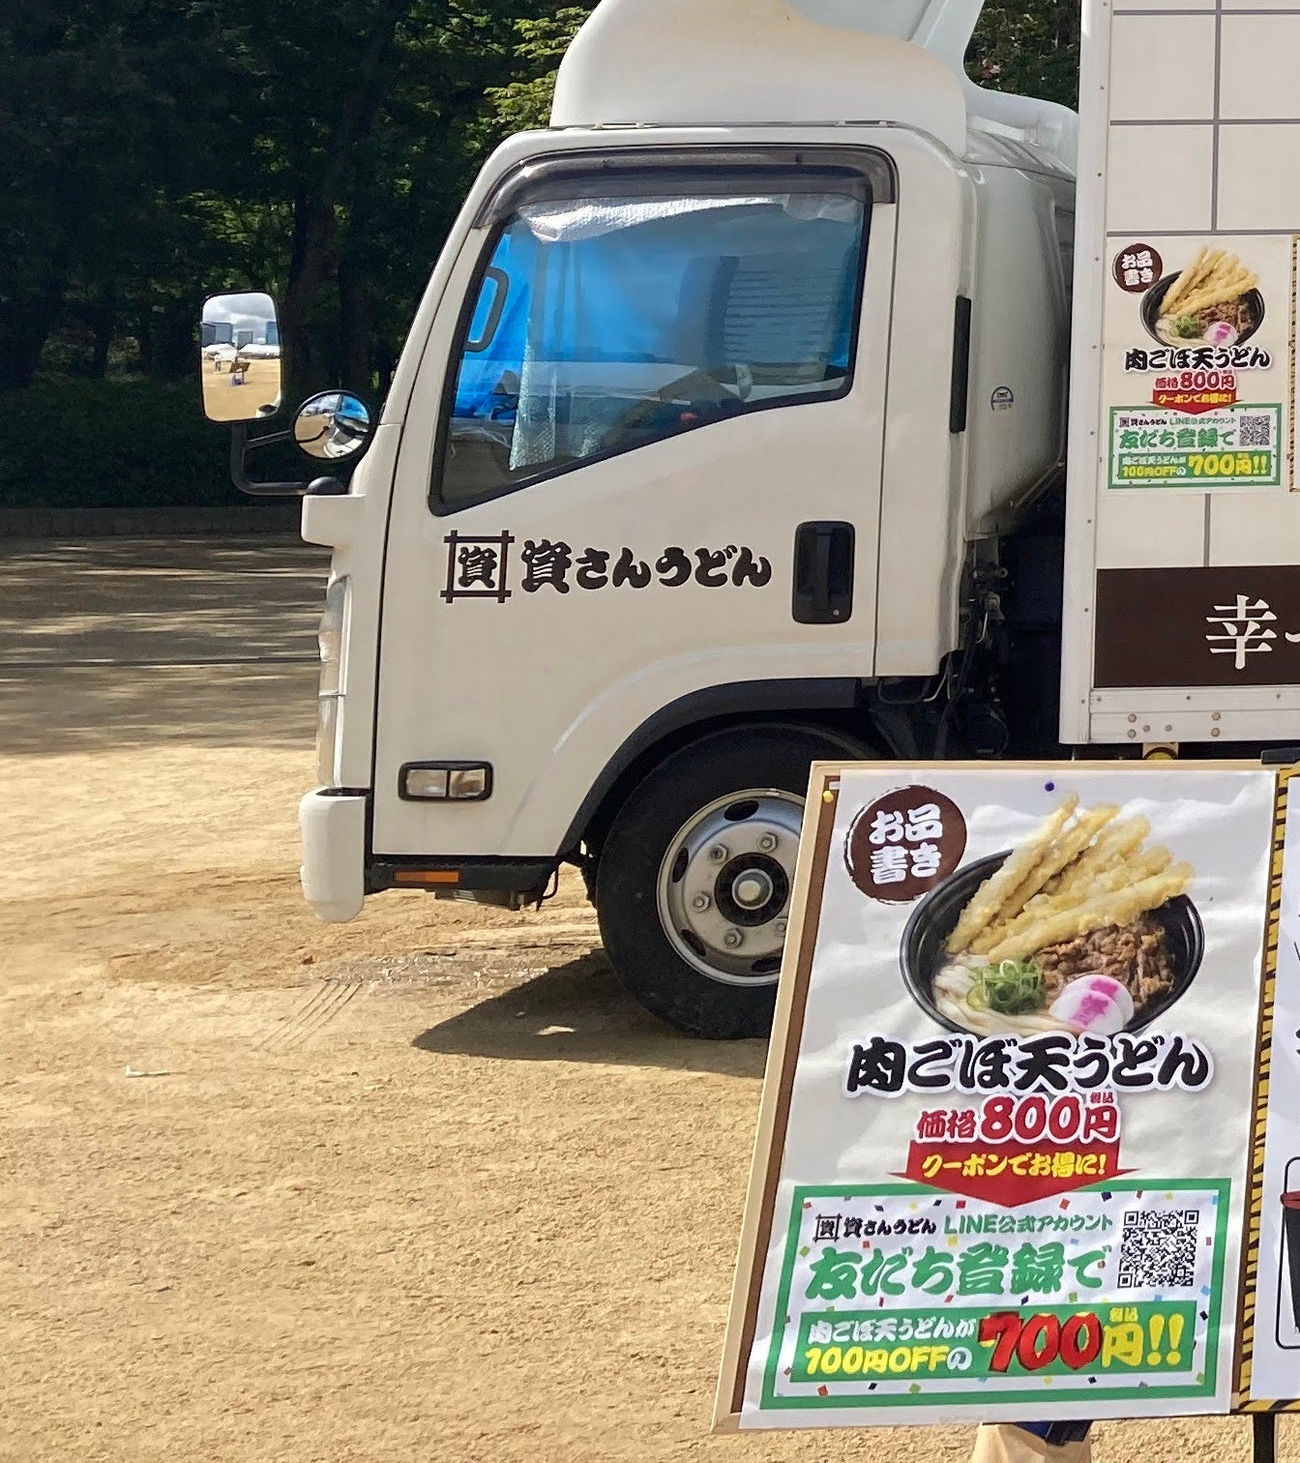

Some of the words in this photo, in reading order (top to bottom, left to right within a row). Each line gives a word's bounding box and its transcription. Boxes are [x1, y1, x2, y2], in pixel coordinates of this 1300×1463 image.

[1119, 427, 1236, 449] 友だち登録で
[520, 538, 773, 595] 資さんうどん
[868, 802, 944, 846] お品
[870, 844, 942, 885] 書き
[845, 1035, 1210, 1092] 肉ごぼ天うどん
[921, 1152, 1107, 1178] クーポンでお得に!
[843, 1215, 937, 1238] 資さんうどん
[943, 1213, 1114, 1236] LINE公式アカウント
[805, 1240, 1111, 1300] 友だち登録で
[808, 1317, 976, 1345] 肉ごぼ天うどんが
[976, 1310, 1185, 1375] 700円!!
[804, 1345, 974, 1376] 100円OFFの
